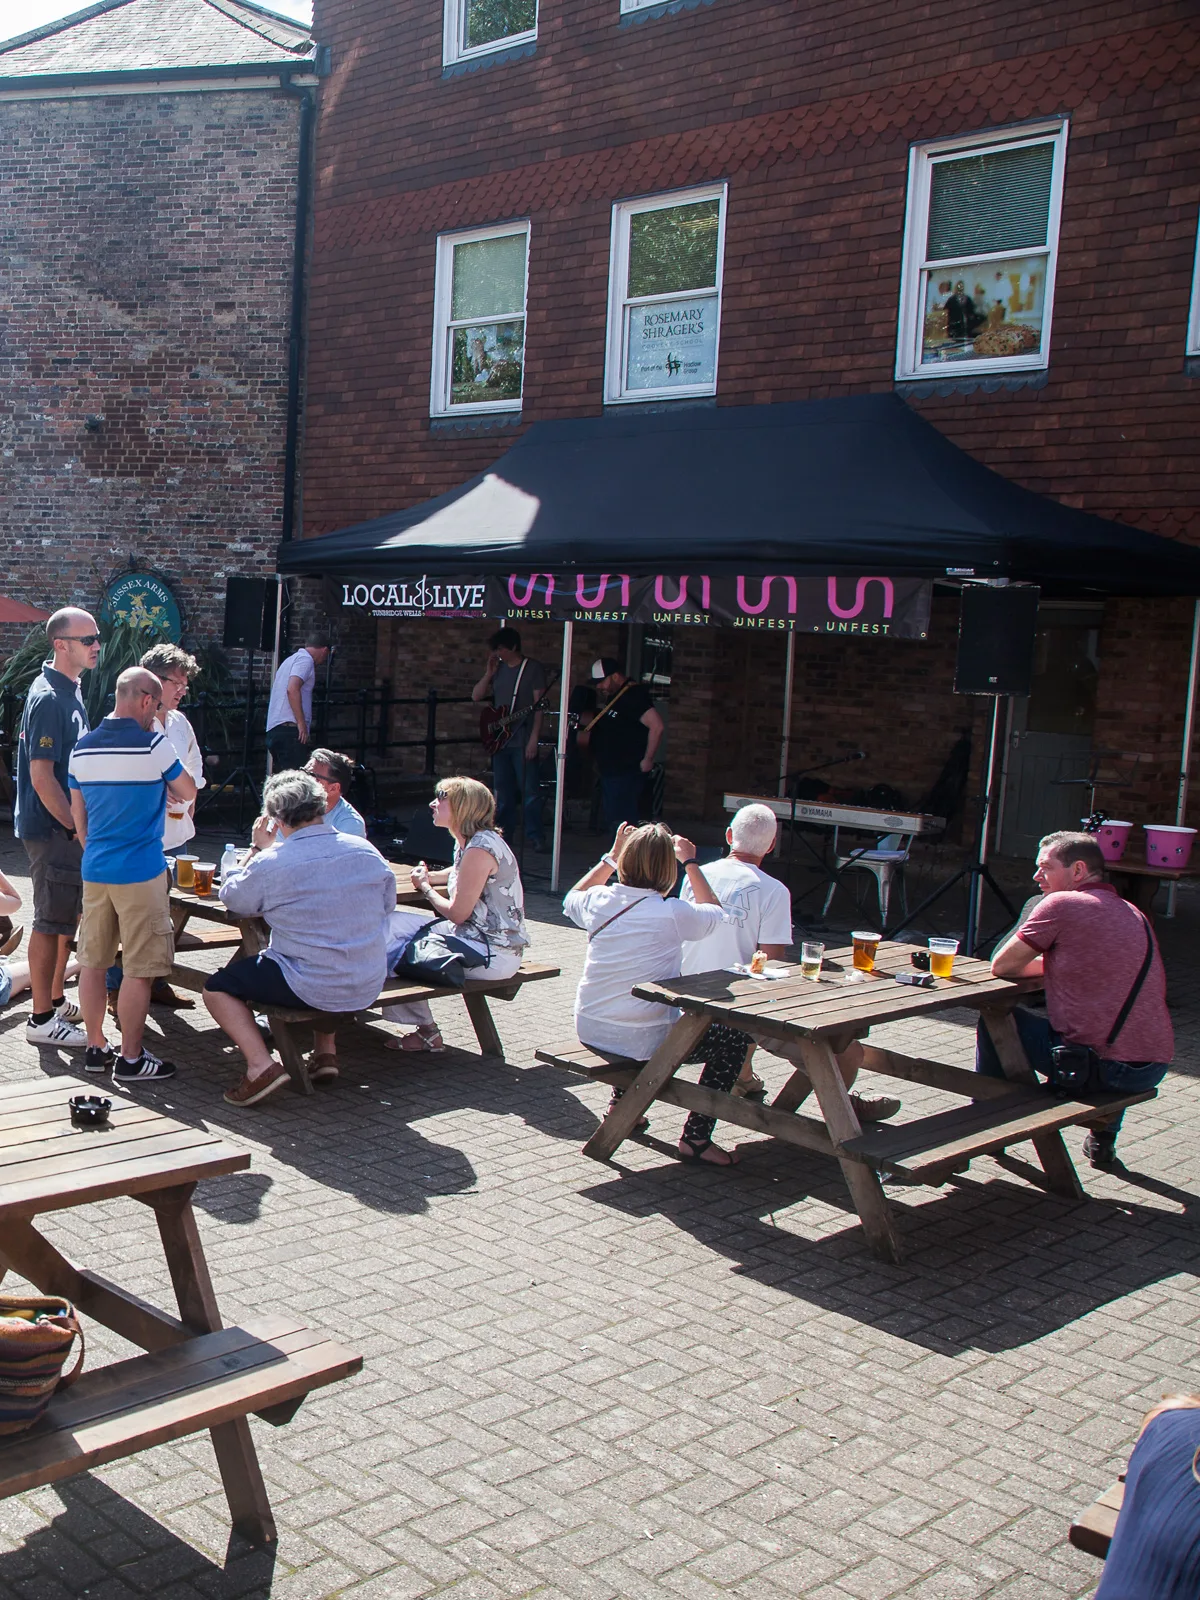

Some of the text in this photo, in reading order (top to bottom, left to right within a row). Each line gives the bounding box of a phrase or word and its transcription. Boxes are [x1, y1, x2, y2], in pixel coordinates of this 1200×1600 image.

[644, 308, 704, 326] ROSEMARY
[642, 321, 704, 340] SHRAGER'S
[110, 580, 168, 607] SUSSEX ARMS
[342, 584, 413, 606] LOCAL
[433, 584, 486, 607] LIVE
[507, 609, 890, 634] UNFEST UNFEST UNFEST UNFEST UNFEST
[808, 807, 833, 817] YAMAHA
